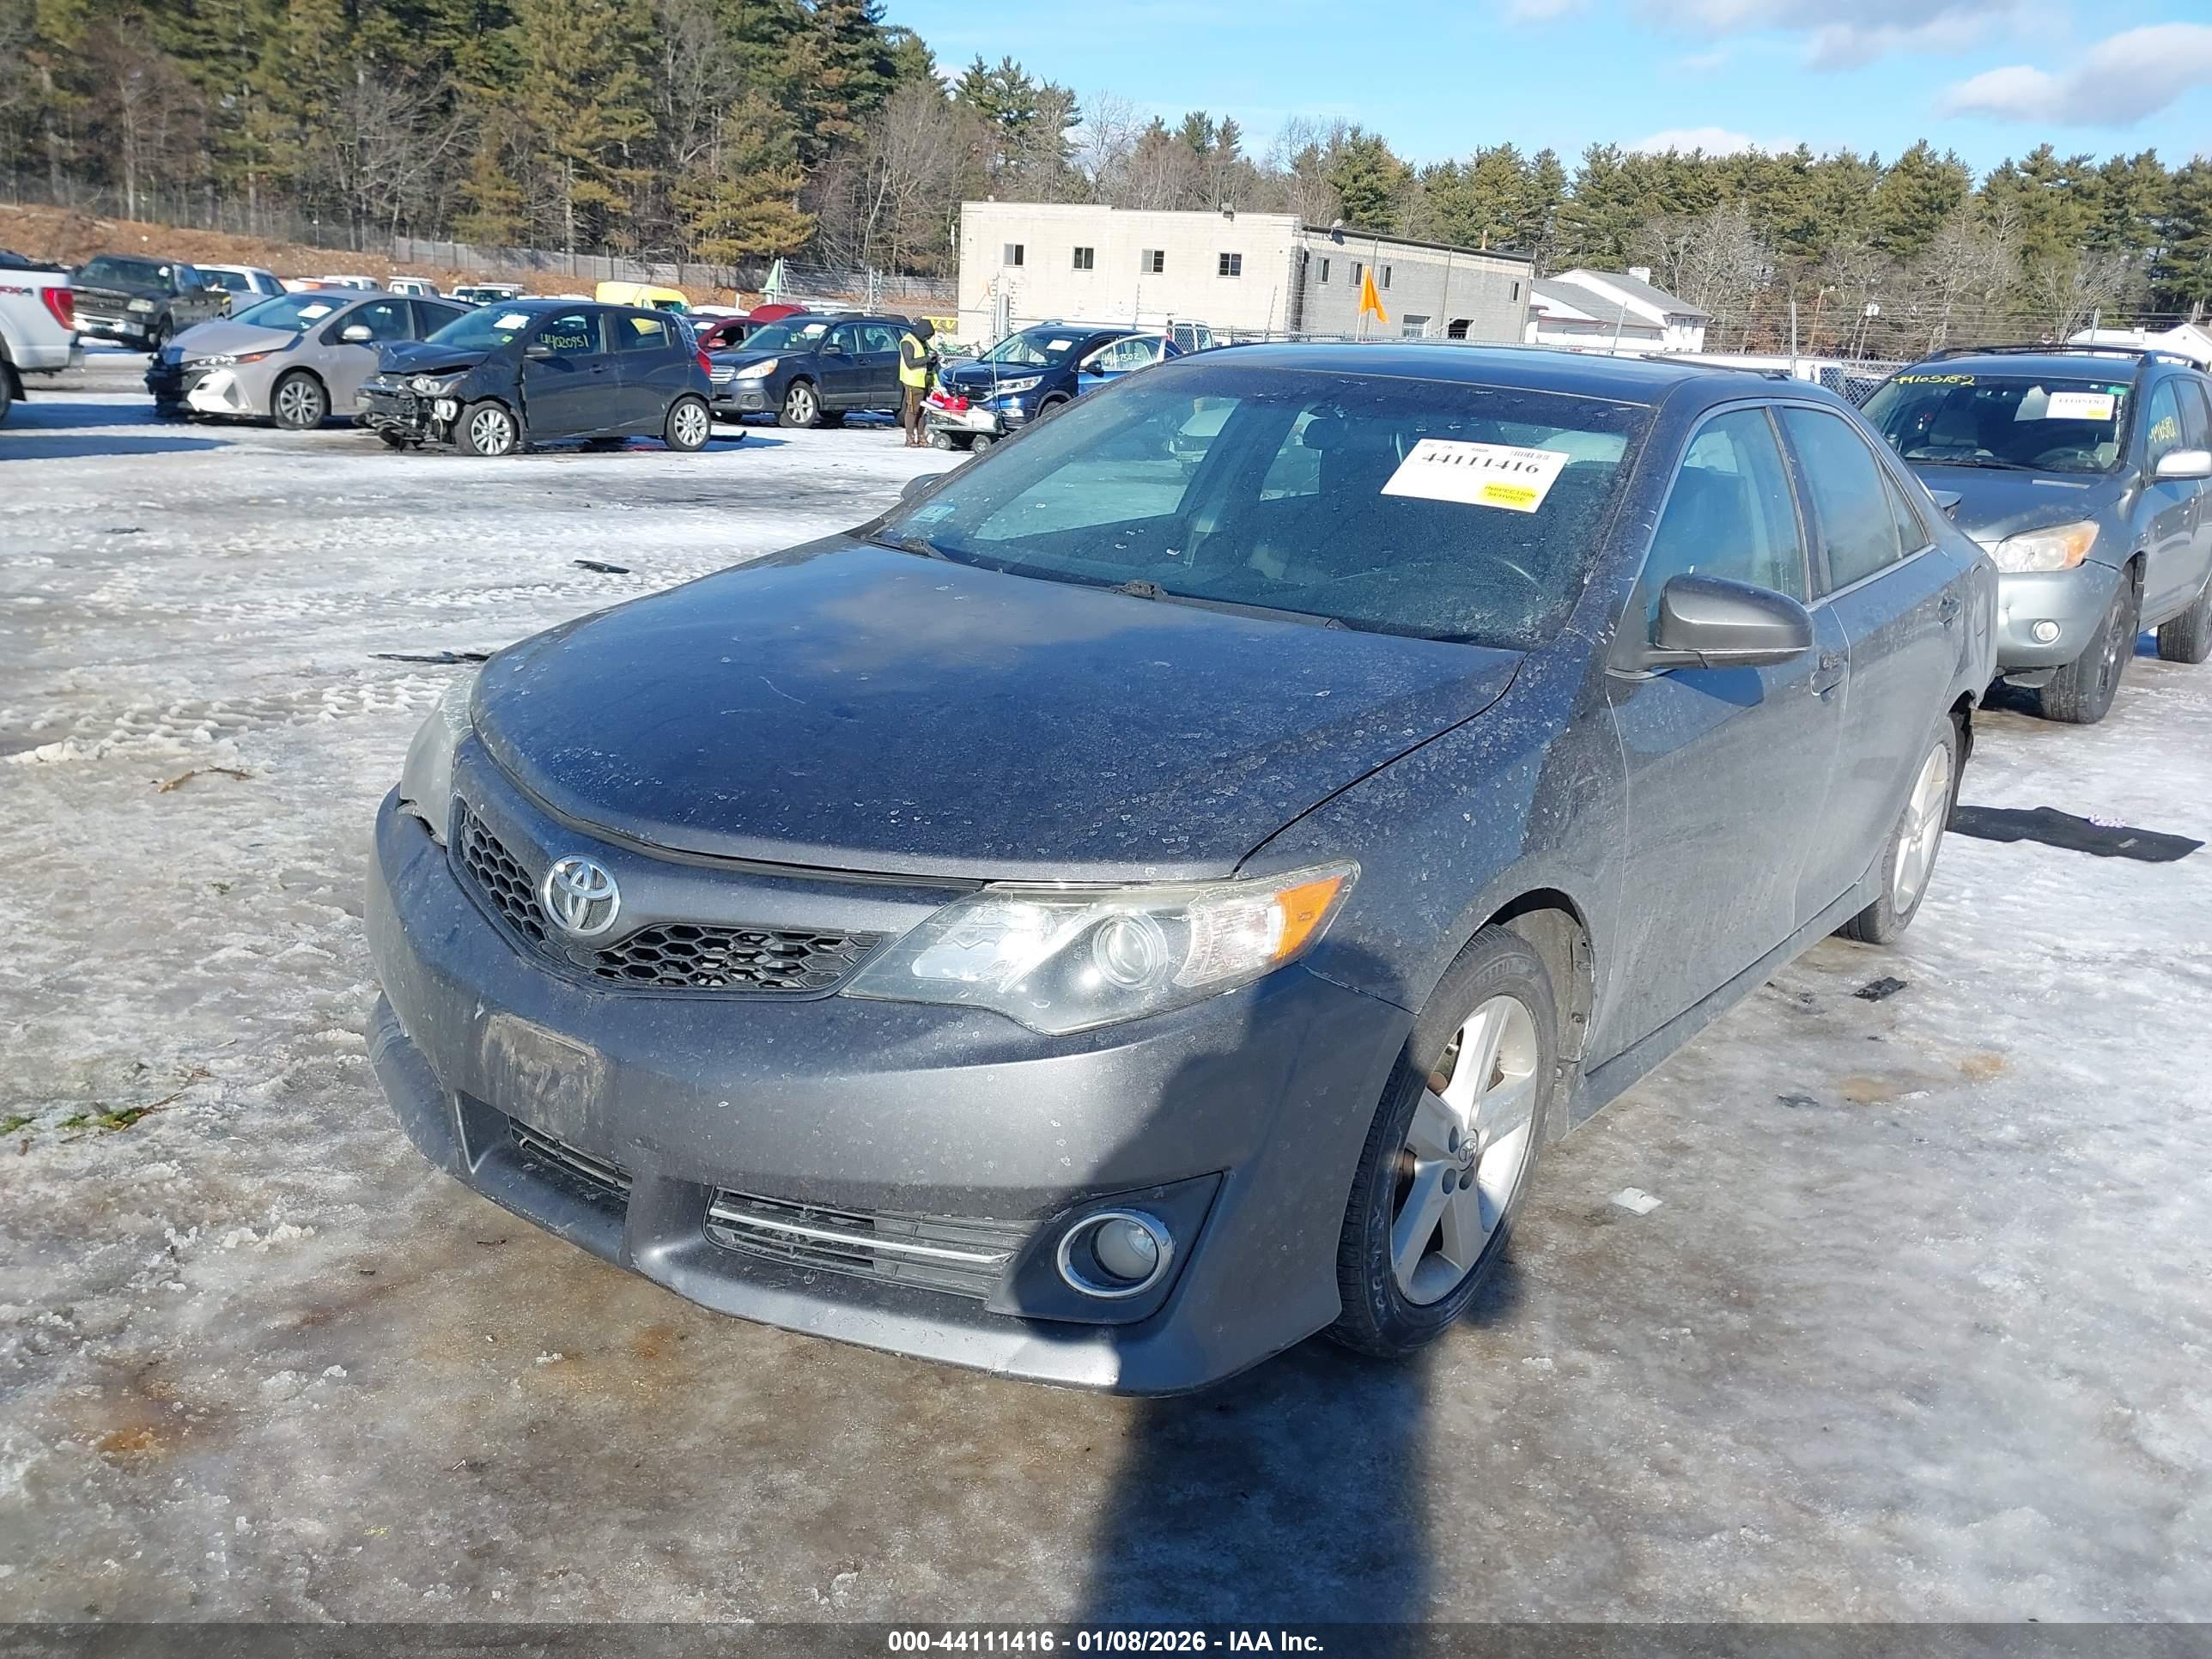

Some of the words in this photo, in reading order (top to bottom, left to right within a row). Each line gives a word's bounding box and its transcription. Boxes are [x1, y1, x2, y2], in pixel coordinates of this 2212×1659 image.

[1422, 453, 1540, 473] 44111416
[1485, 485, 1536, 498] INSPECTION
[1486, 491, 1527, 502] SERVICE
